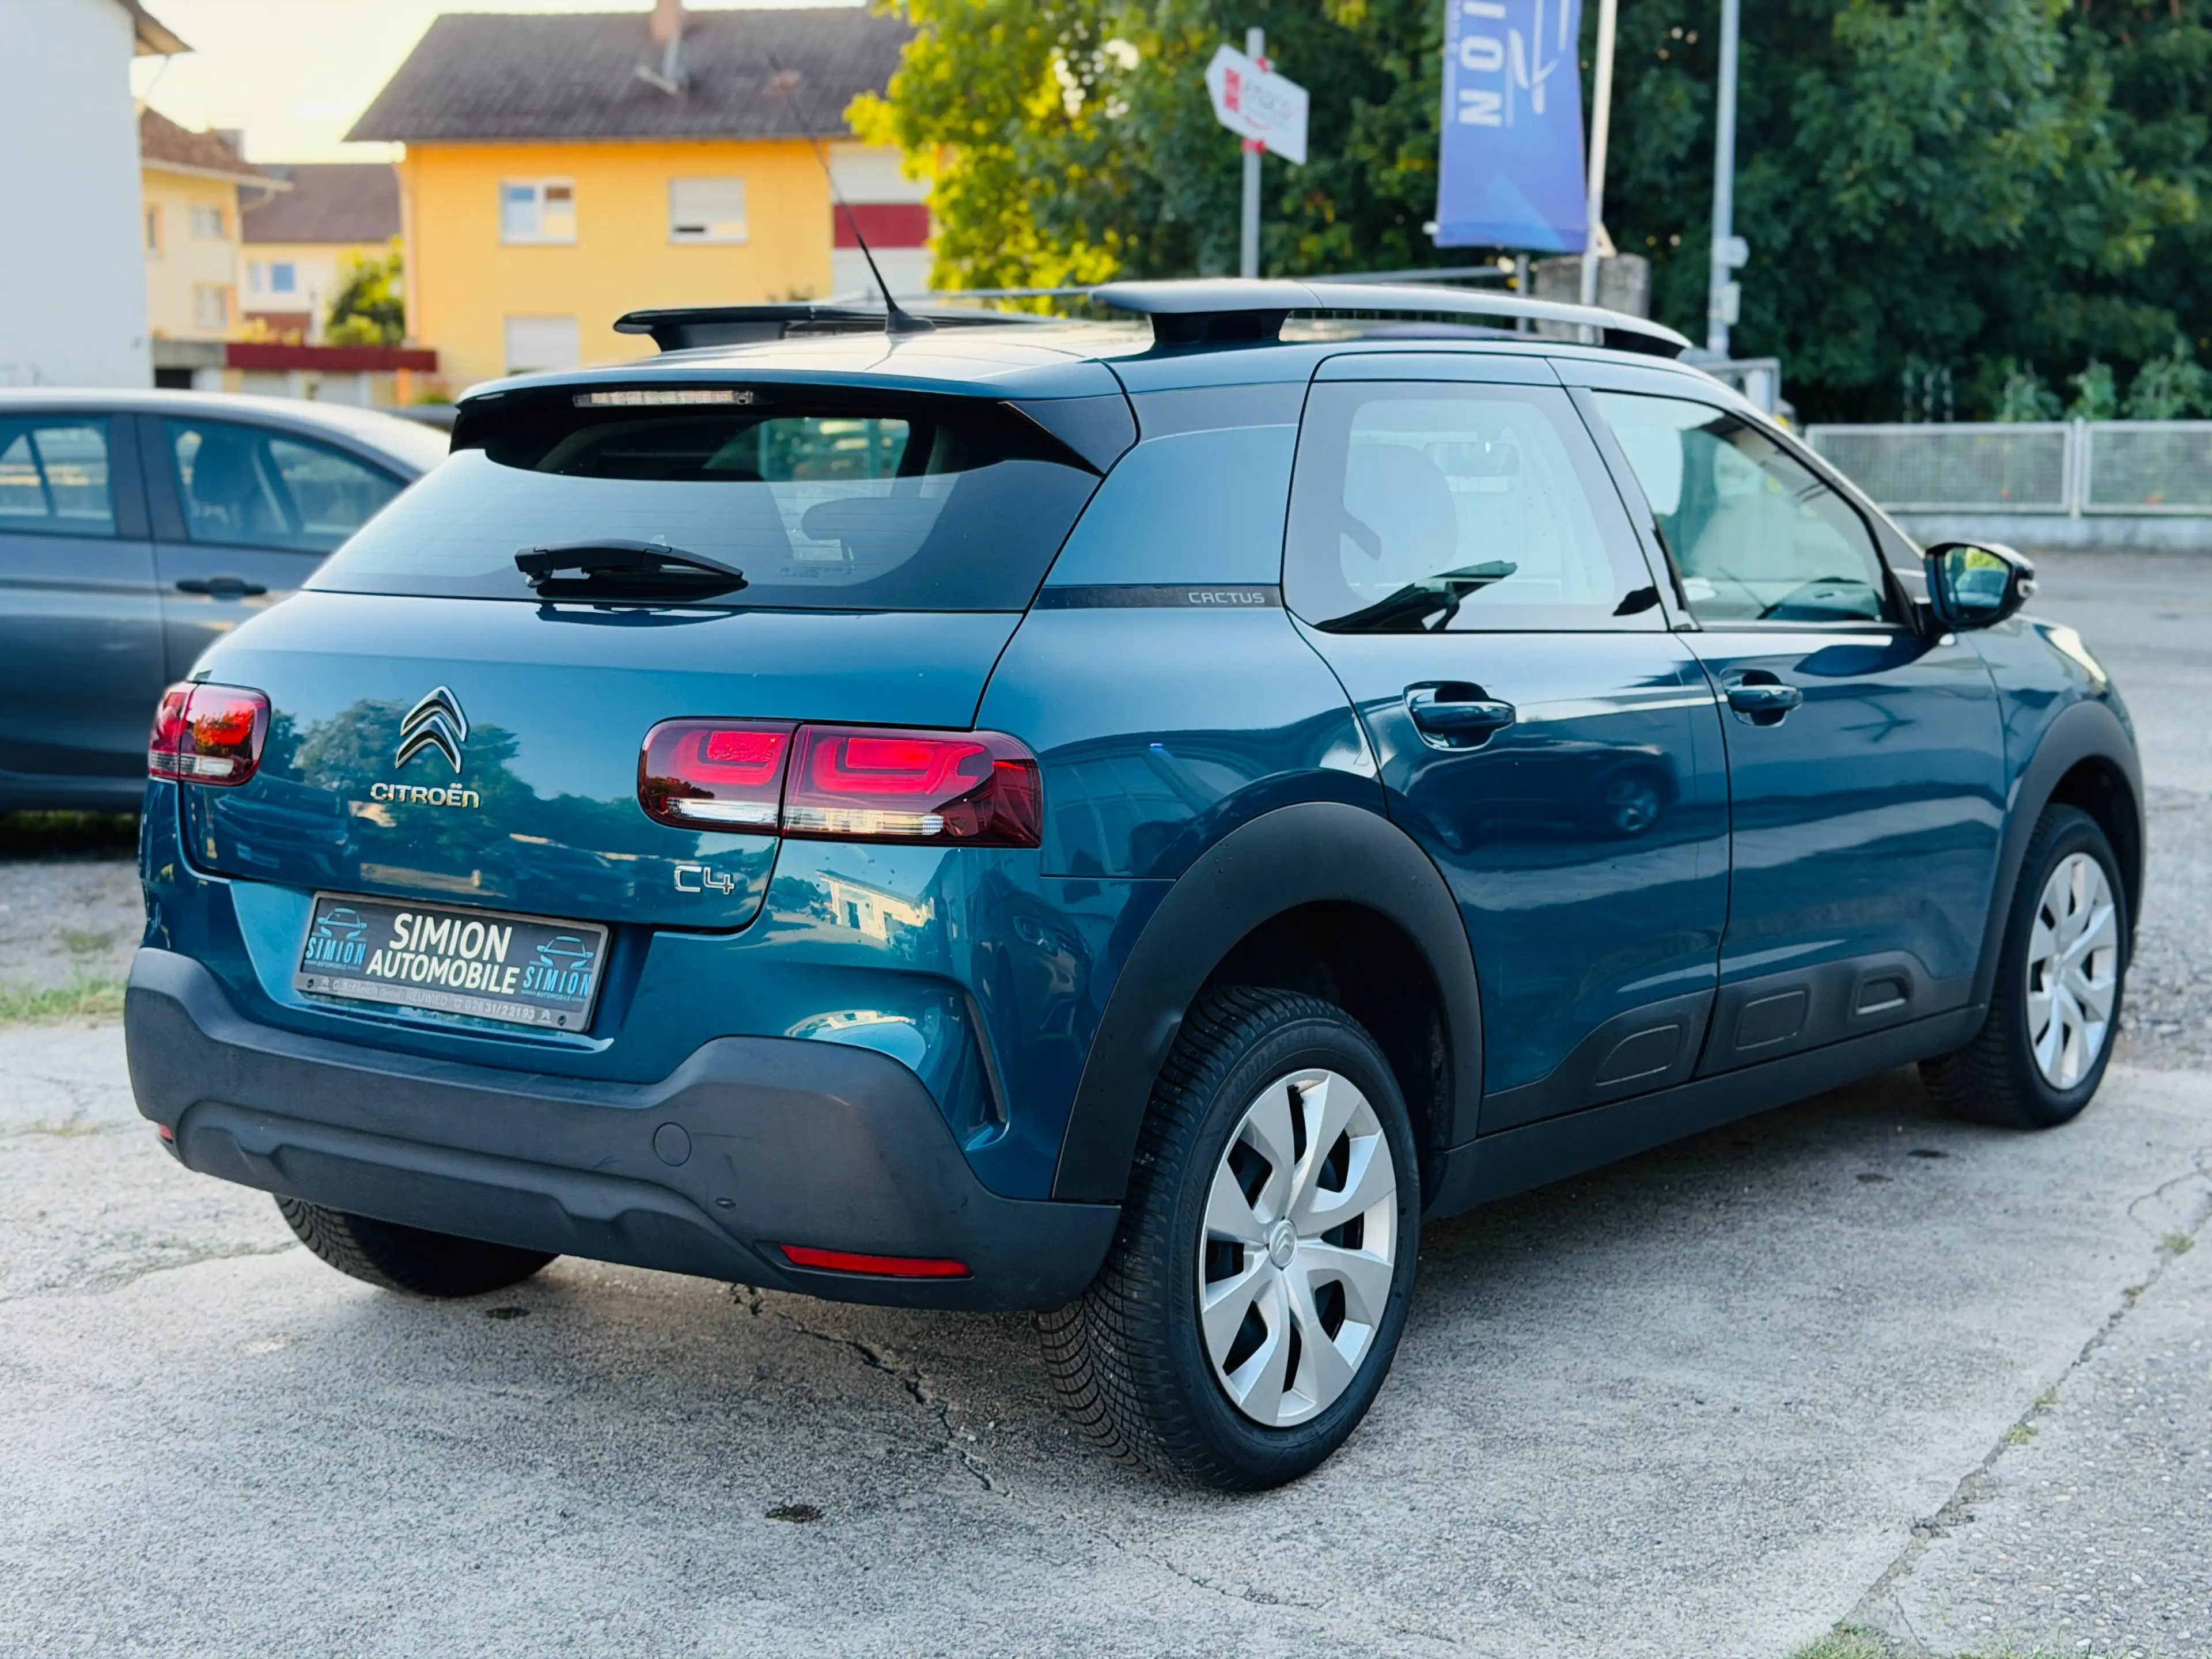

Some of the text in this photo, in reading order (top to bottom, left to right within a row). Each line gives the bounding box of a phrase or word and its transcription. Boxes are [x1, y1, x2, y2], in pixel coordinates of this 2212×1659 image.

[1188, 592, 1265, 605] CACTUS
[673, 865, 735, 895] C4
[305, 937, 367, 966] SIMION
[389, 912, 513, 963] SIMION
[366, 948, 520, 995] AUTOMOBILE
[523, 967, 593, 997] SIMION
[406, 989, 448, 1006] NEUWIED
